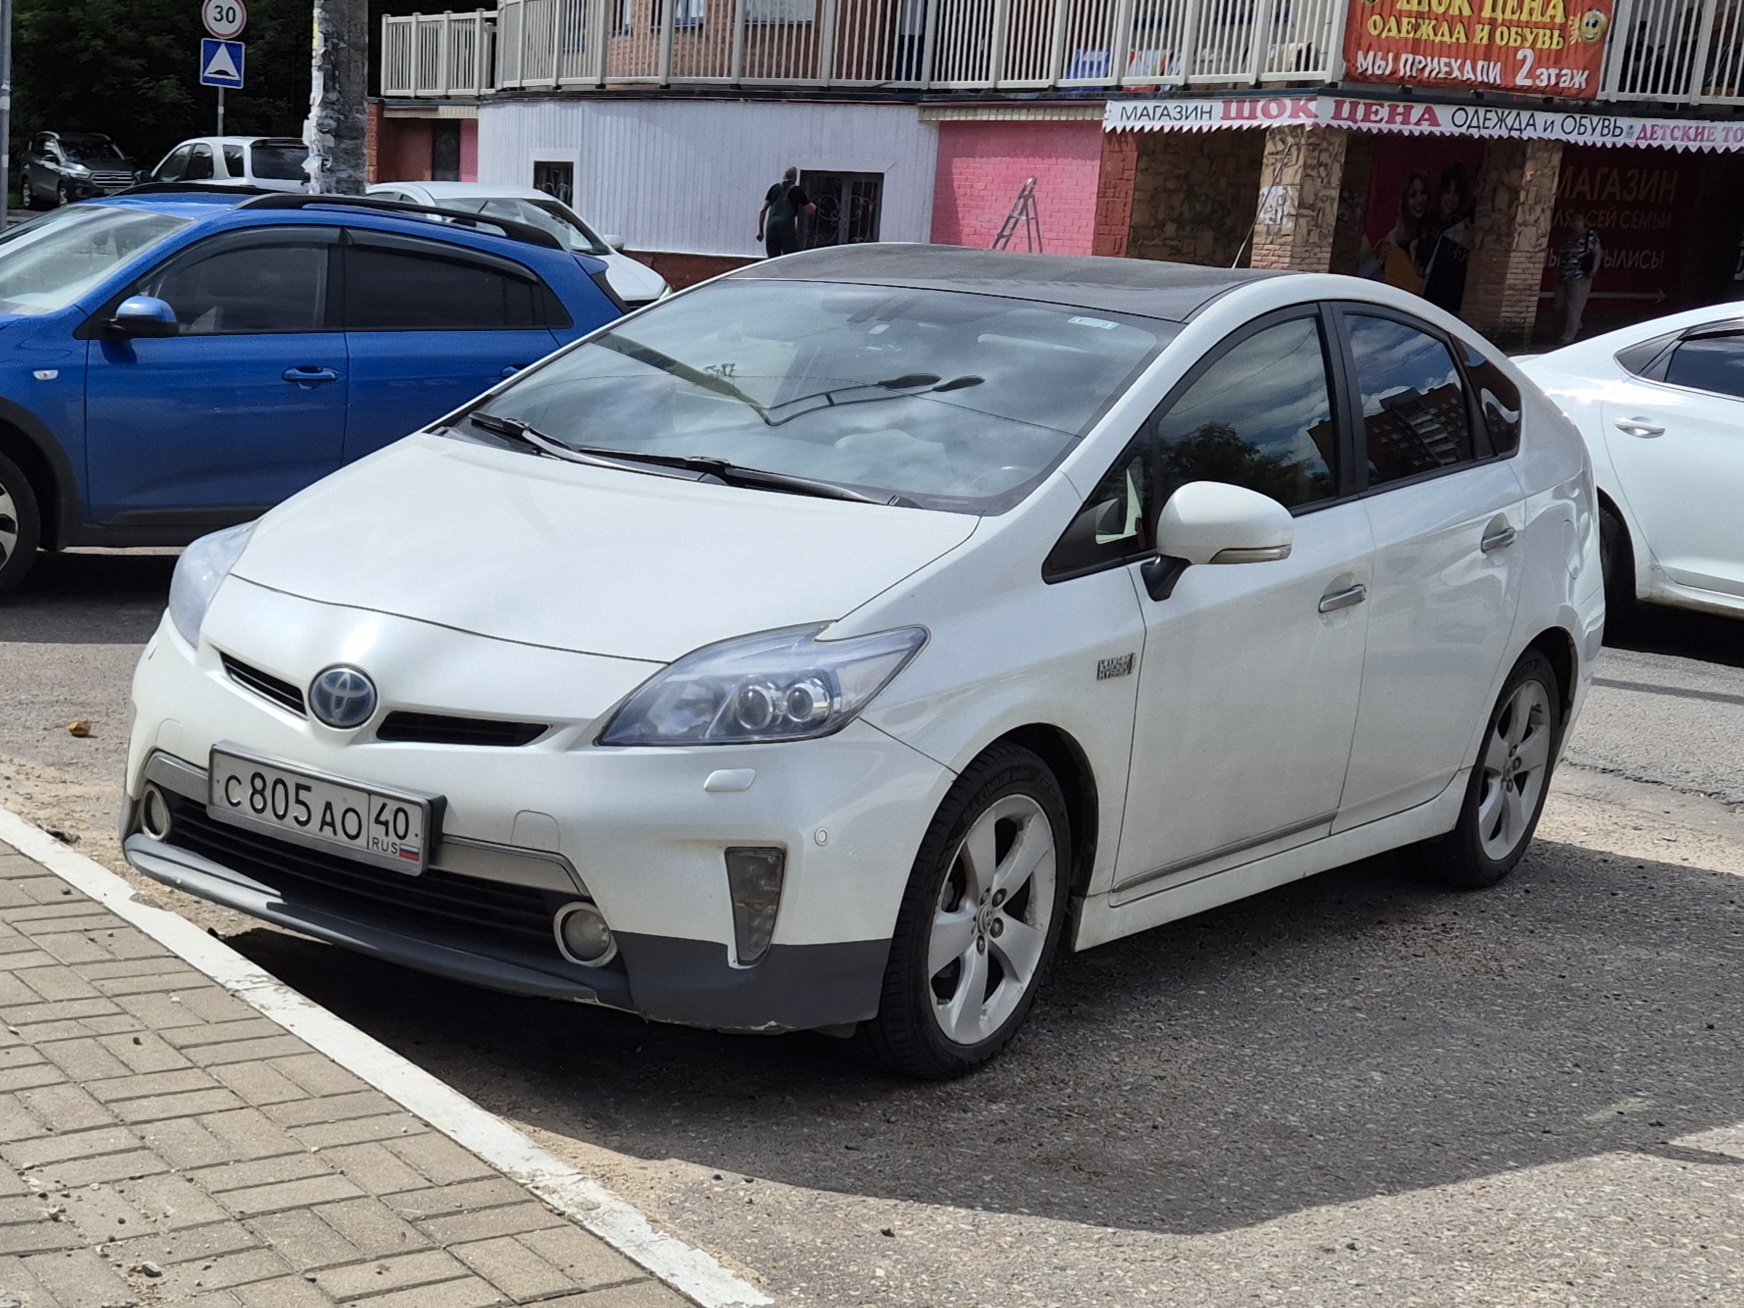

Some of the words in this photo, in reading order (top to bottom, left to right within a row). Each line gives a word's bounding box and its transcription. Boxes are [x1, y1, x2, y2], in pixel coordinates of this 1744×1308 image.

[213, 4, 237, 24] 30
[1480, 0, 1567, 24] ЦЕНА
[1367, 14, 1468, 44] ОДЕЖДА
[1473, 23, 1492, 45] И
[1495, 25, 1565, 50] ОБУВЬ
[1356, 50, 1394, 76] МЫ
[1400, 53, 1502, 84] ПРИЕХАЛИ
[1515, 48, 1535, 86] 2
[1536, 67, 1590, 89] этаж
[1119, 103, 1213, 121] МАГАЗИН
[1220, 97, 1320, 121] ШОК
[1330, 99, 1442, 128] ЦЕНА
[1451, 107, 1537, 133] ОДЕЖДА
[1543, 119, 1554, 134] и
[1560, 114, 1624, 138] ОБУВЬ
[1636, 123, 1718, 143] ДЕТСКИЕ
[1552, 208, 1575, 227] ЛЯ
[1619, 209, 1673, 231] СЕМЬИ
[224, 771, 363, 841] С805АО
[374, 802, 410, 841] 40
[371, 836, 399, 855] RUS
